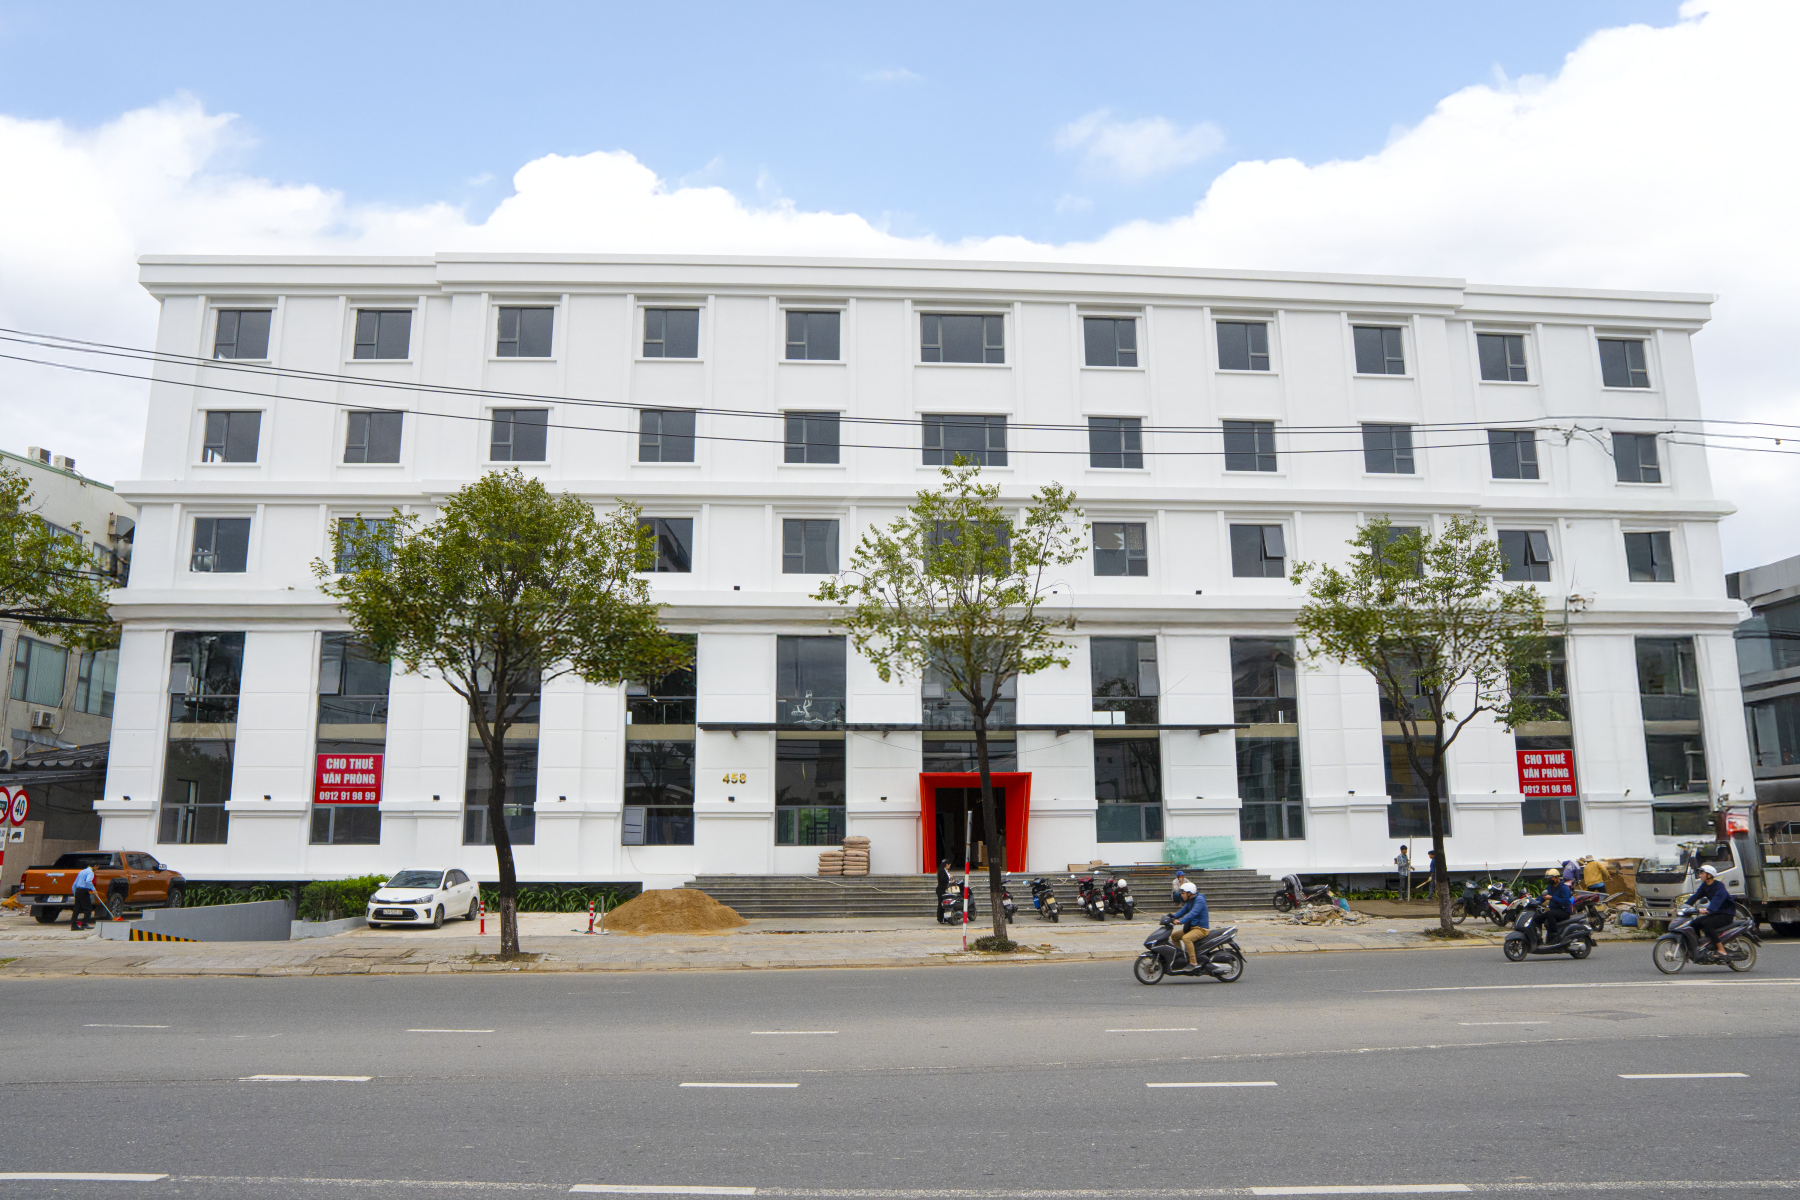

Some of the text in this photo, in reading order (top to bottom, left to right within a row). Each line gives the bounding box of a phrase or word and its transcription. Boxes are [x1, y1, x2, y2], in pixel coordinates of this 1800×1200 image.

[326, 756, 374, 769] CHO THUÊ
[1524, 752, 1566, 765] CHO THUÊ
[322, 772, 375, 784] VĂN PHÒNG
[1523, 766, 1569, 778] VĂN PHÒNG
[722, 773, 747, 784] 458
[1523, 784, 1572, 794] 0912 91 98 99
[319, 791, 376, 801] 0912 91 98 99
[15, 799, 25, 816] 40
